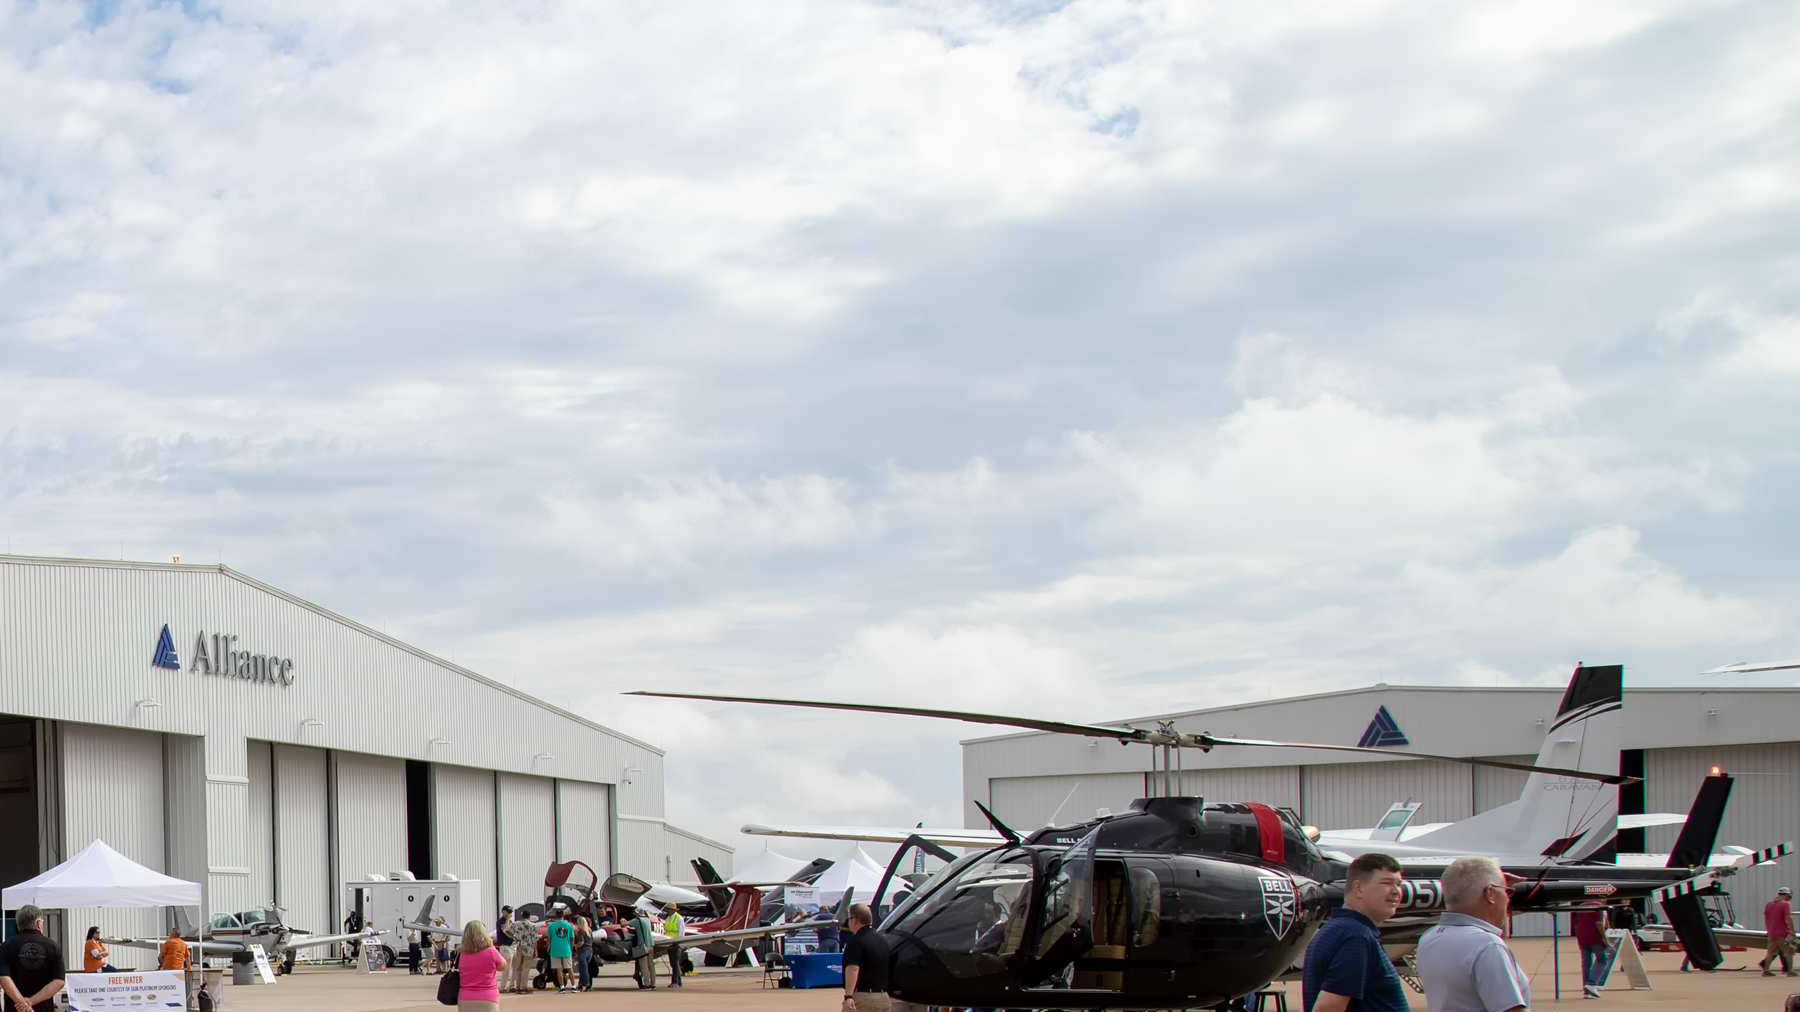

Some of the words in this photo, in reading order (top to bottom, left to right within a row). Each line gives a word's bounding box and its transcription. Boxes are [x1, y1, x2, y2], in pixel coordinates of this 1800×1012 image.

[190, 629, 295, 686] Alliance
[1262, 880, 1292, 892] BELL
[108, 976, 122, 985] FREE
[123, 976, 144, 984] WATER
